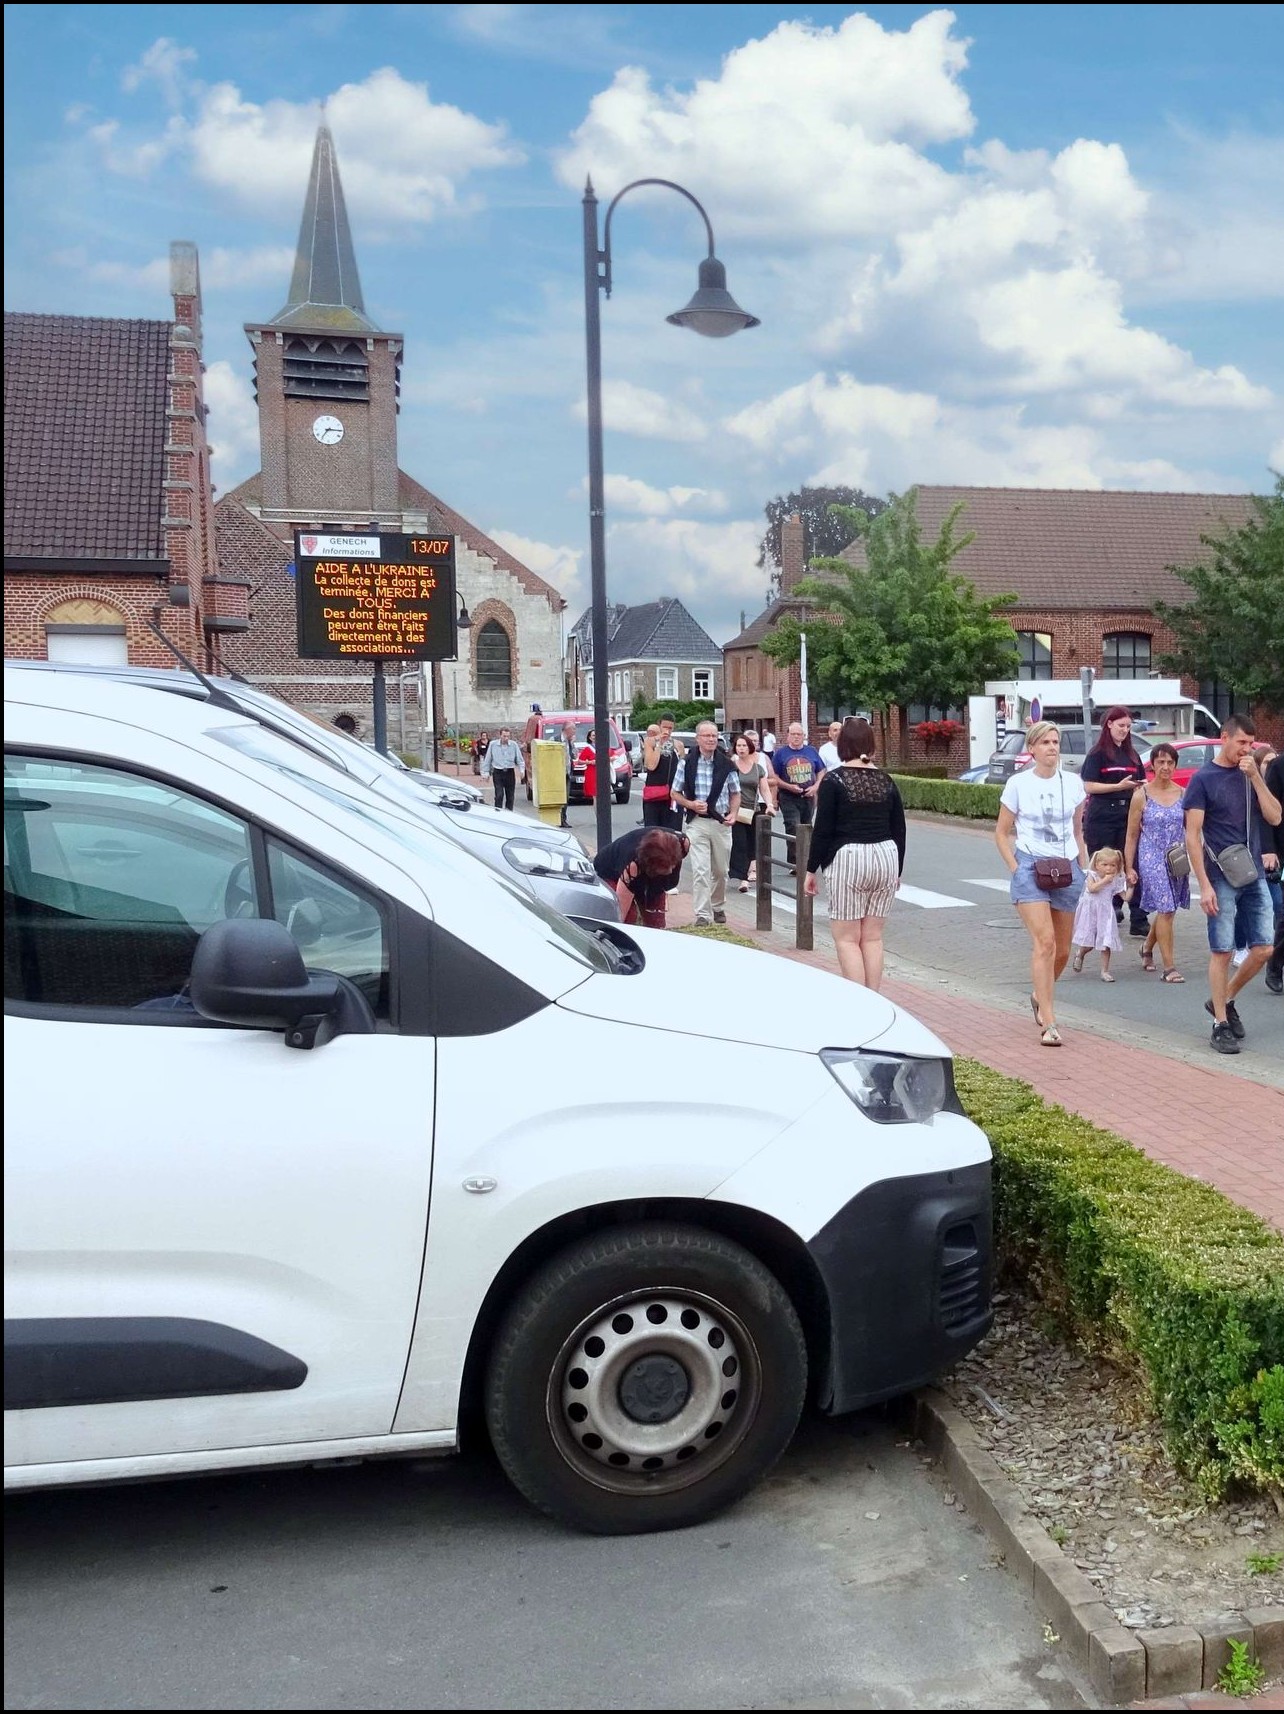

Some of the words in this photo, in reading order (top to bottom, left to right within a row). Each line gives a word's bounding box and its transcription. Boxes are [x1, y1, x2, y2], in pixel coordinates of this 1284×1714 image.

[329, 537, 367, 545] GENECH
[411, 539, 449, 555] 13/07
[322, 547, 375, 556] Informations
[315, 562, 348, 574] AIDE
[364, 563, 433, 577] L'UKRAINE:
[314, 574, 327, 585] La
[330, 574, 371, 586] collecte
[374, 575, 388, 587] de
[391, 576, 416, 587] dons
[420, 577, 436, 588] est
[320, 585, 372, 597] terminée.
[376, 587, 417, 599] MERCI
[357, 597, 397, 609] TOUS.
[323, 608, 345, 619] Des
[349, 609, 374, 620] dons
[378, 609, 428, 621] financiers
[328, 620, 373, 632] peuvent
[377, 619, 398, 631] être
[402, 620, 425, 632] faits
[328, 631, 392, 642] directement
[396, 631, 403, 642] à
[406, 631, 425, 643] des
[339, 642, 415, 654] associations...
